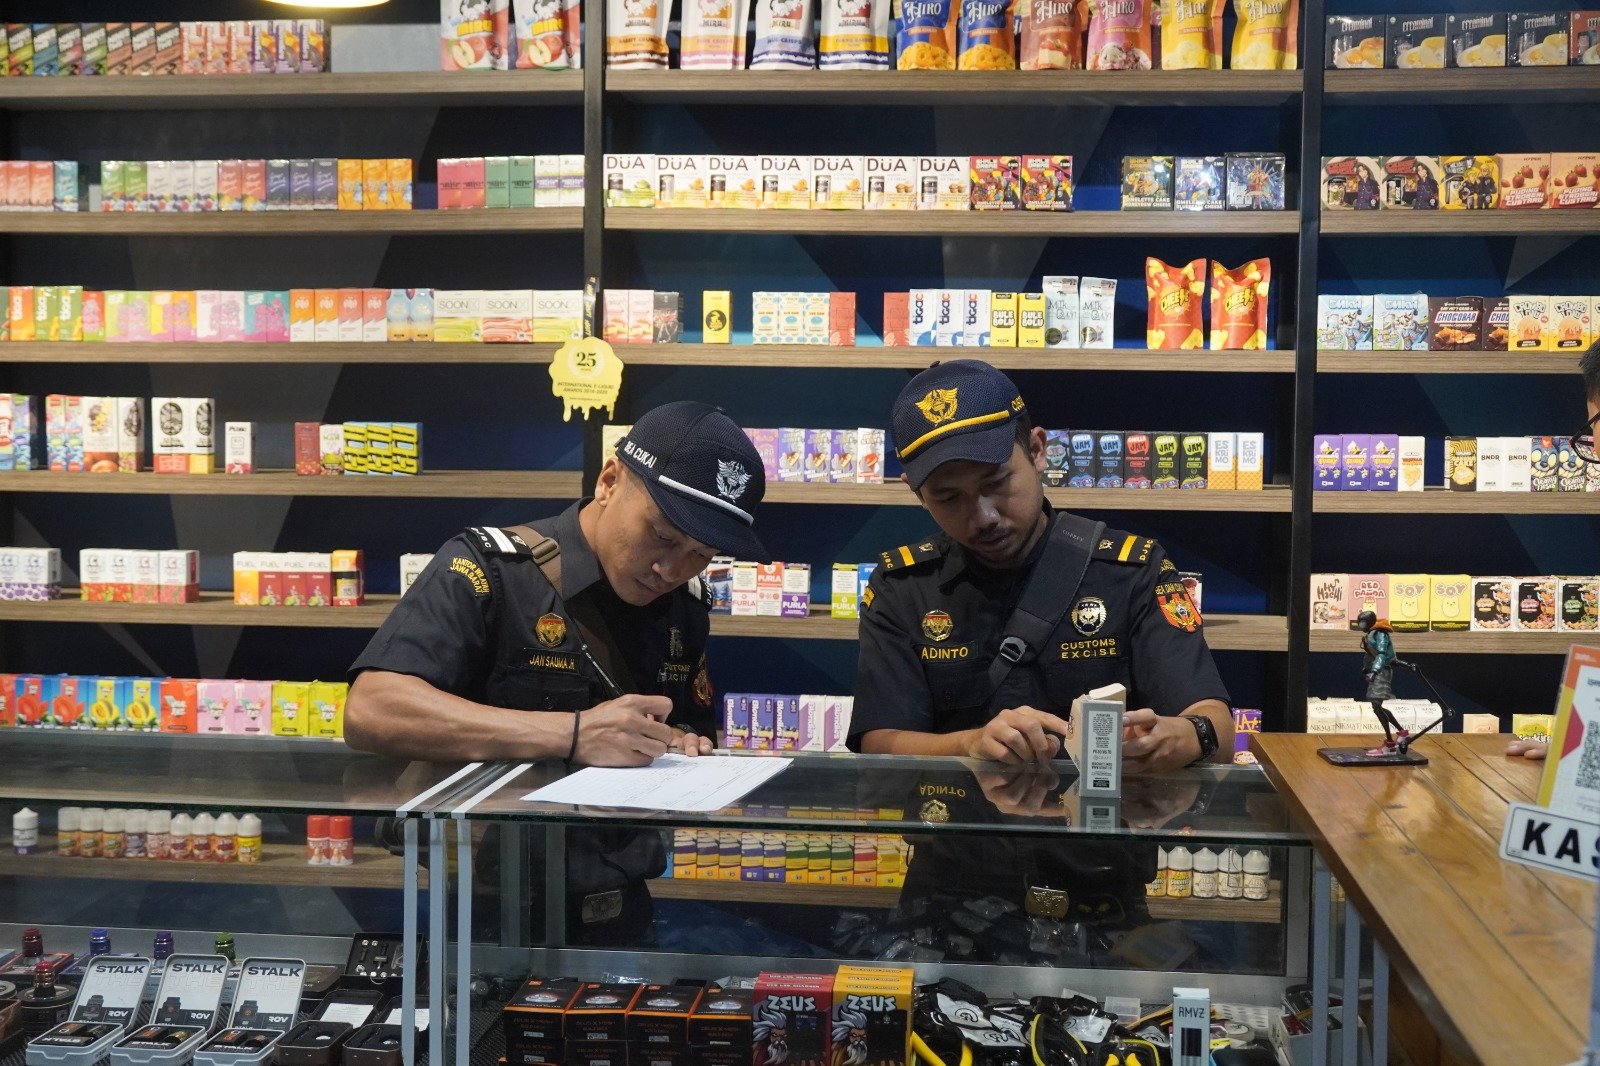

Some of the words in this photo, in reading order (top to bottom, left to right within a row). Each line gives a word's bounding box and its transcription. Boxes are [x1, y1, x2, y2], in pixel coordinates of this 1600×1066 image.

[904, 1, 941, 24] HIRO
[1035, 2, 1073, 24] HIRO
[1510, 187, 1540, 196] PUDING
[1563, 186, 1594, 195] PUDING
[1504, 192, 1545, 202] STROBERI
[1557, 191, 1599, 201] STROBERI
[1505, 198, 1544, 206] CUSTARD
[1559, 197, 1598, 205] CUSTARD
[1436, 312, 1477, 322] CHOCOBAR
[576, 352, 597, 368] 25
[1074, 441, 1091, 450] JAM
[1102, 441, 1119, 450] JAM
[1130, 442, 1146, 451] JAM
[1159, 443, 1175, 452] JAM
[1187, 443, 1203, 453] JAM
[1215, 440, 1229, 449] ES
[1243, 441, 1256, 450] ES
[633, 448, 658, 469] CUKAI
[1215, 456, 1229, 464] MO
[1243, 457, 1256, 465] MO
[1481, 454, 1500, 462] BNDR
[1508, 454, 1528, 462] BNDR
[453, 557, 477, 572] KANTOR
[450, 564, 469, 576] JAWA
[467, 572, 483, 594] BARAT
[757, 574, 782, 583] FURLA
[1361, 581, 1379, 589] RED
[1354, 589, 1386, 599] PANDA
[1395, 583, 1426, 597] SOY
[1435, 583, 1467, 597] SOY
[782, 601, 807, 609] FURLA
[832, 602, 856, 610] FURLA
[1061, 637, 1116, 650] CUSTOMS
[921, 646, 969, 660] ADINTO
[1061, 648, 1117, 660] EXCISE
[529, 655, 545, 667] JAN
[1310, 724, 1336, 732] NIKMAT
[1335, 723, 1360, 731] NIKMAT
[1362, 724, 1384, 732] NIKMA
[95, 964, 146, 974] STALK
[172, 963, 225, 974] STALK
[248, 966, 301, 977] STALK
[766, 995, 816, 1011] ZEUS
[846, 995, 898, 1011] ZEUS
[107, 1010, 129, 1018] ROV
[190, 1012, 211, 1021] ROV
[268, 1015, 289, 1023] ROV
